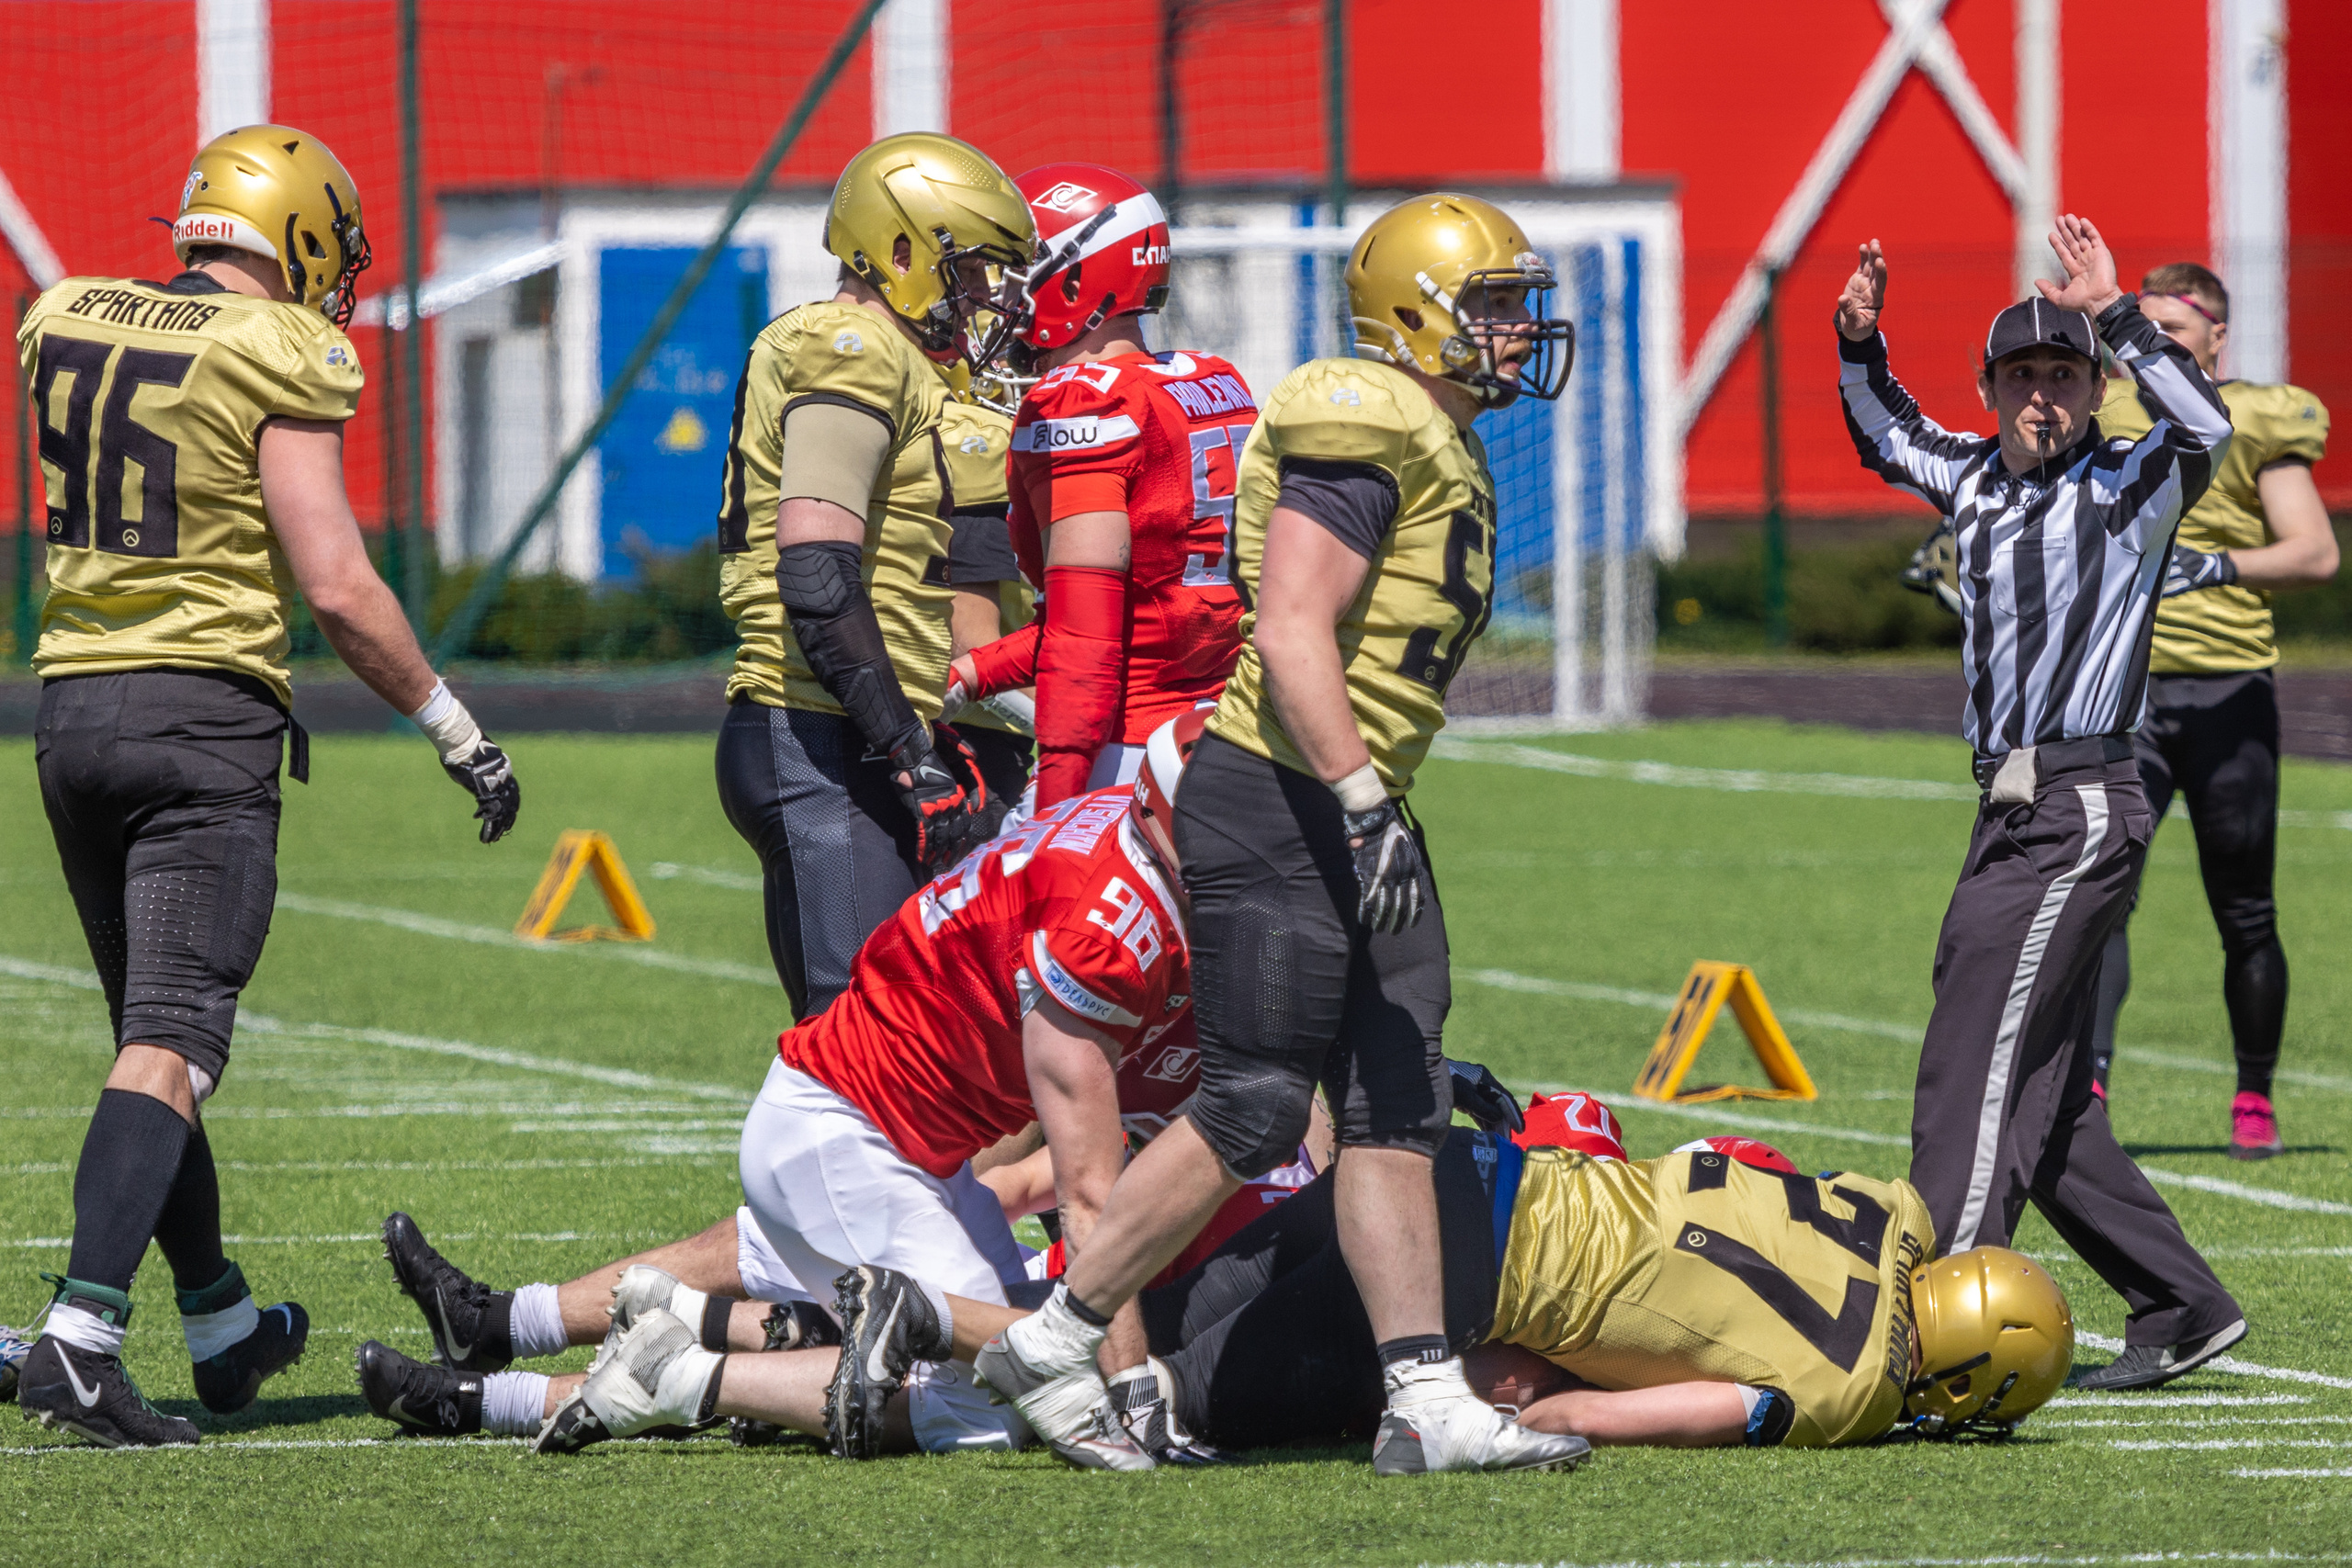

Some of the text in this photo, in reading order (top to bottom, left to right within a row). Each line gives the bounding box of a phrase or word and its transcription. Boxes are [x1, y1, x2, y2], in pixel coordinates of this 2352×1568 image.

[174, 220, 235, 243] Riddell
[65, 288, 223, 332] SPARTANS
[33, 333, 199, 558] 96
[1086, 876, 1162, 972] 96
